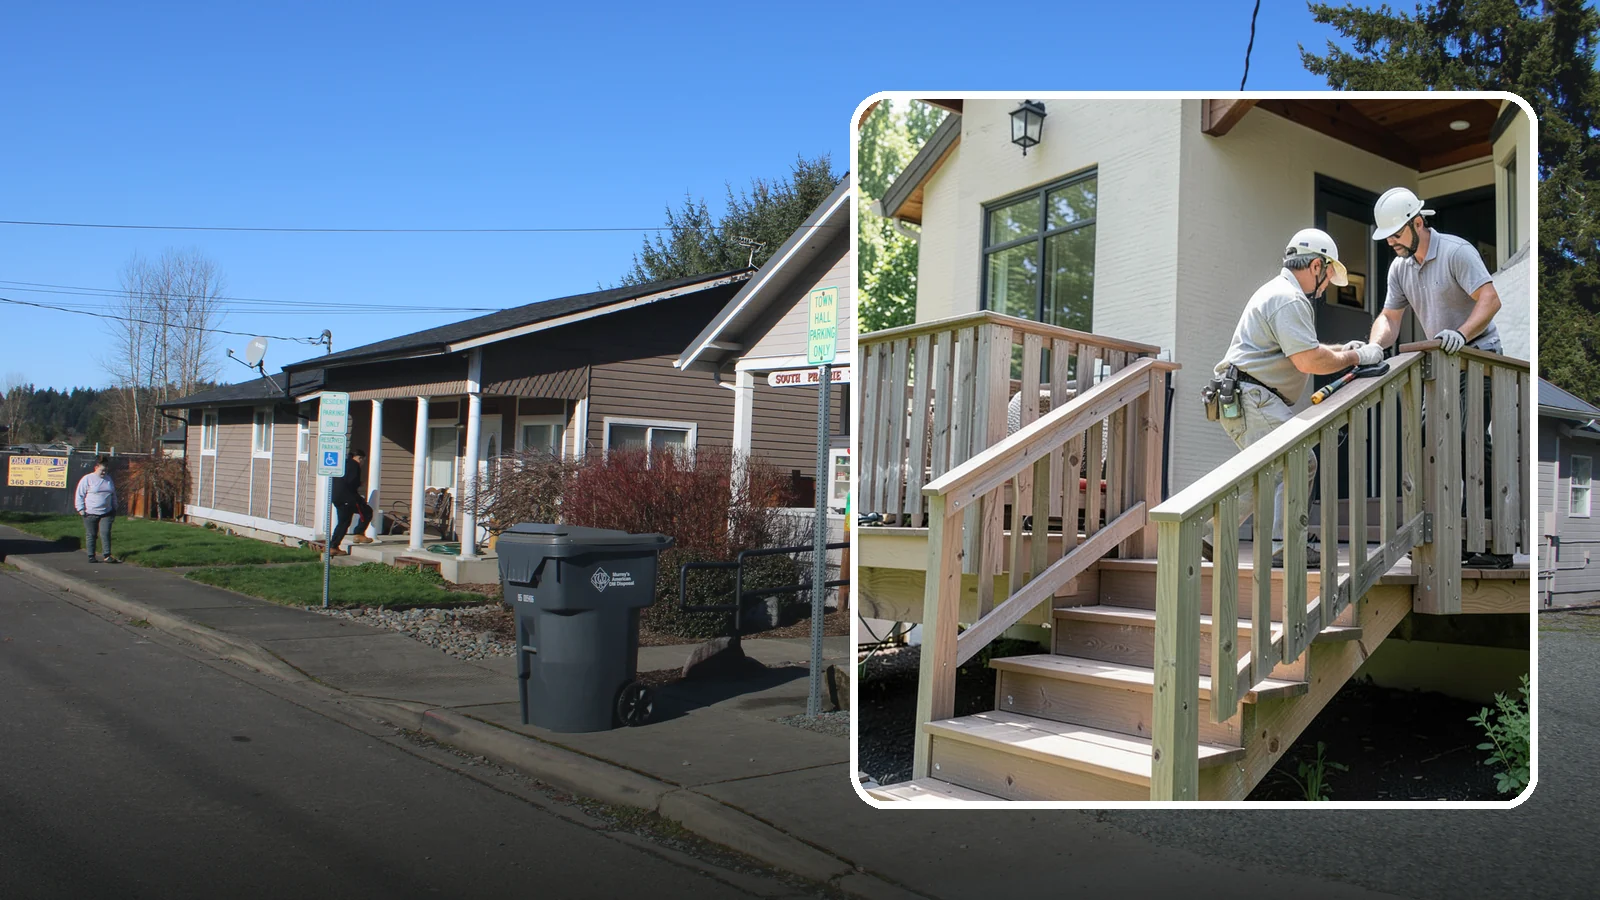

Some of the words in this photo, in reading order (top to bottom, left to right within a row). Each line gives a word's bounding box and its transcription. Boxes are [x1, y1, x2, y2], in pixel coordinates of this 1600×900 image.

[815, 294, 833, 308] TOWN
[814, 312, 831, 324] HALL
[810, 326, 836, 341] PARKING
[814, 344, 830, 357] ONLY
[775, 373, 801, 384] SOUTH
